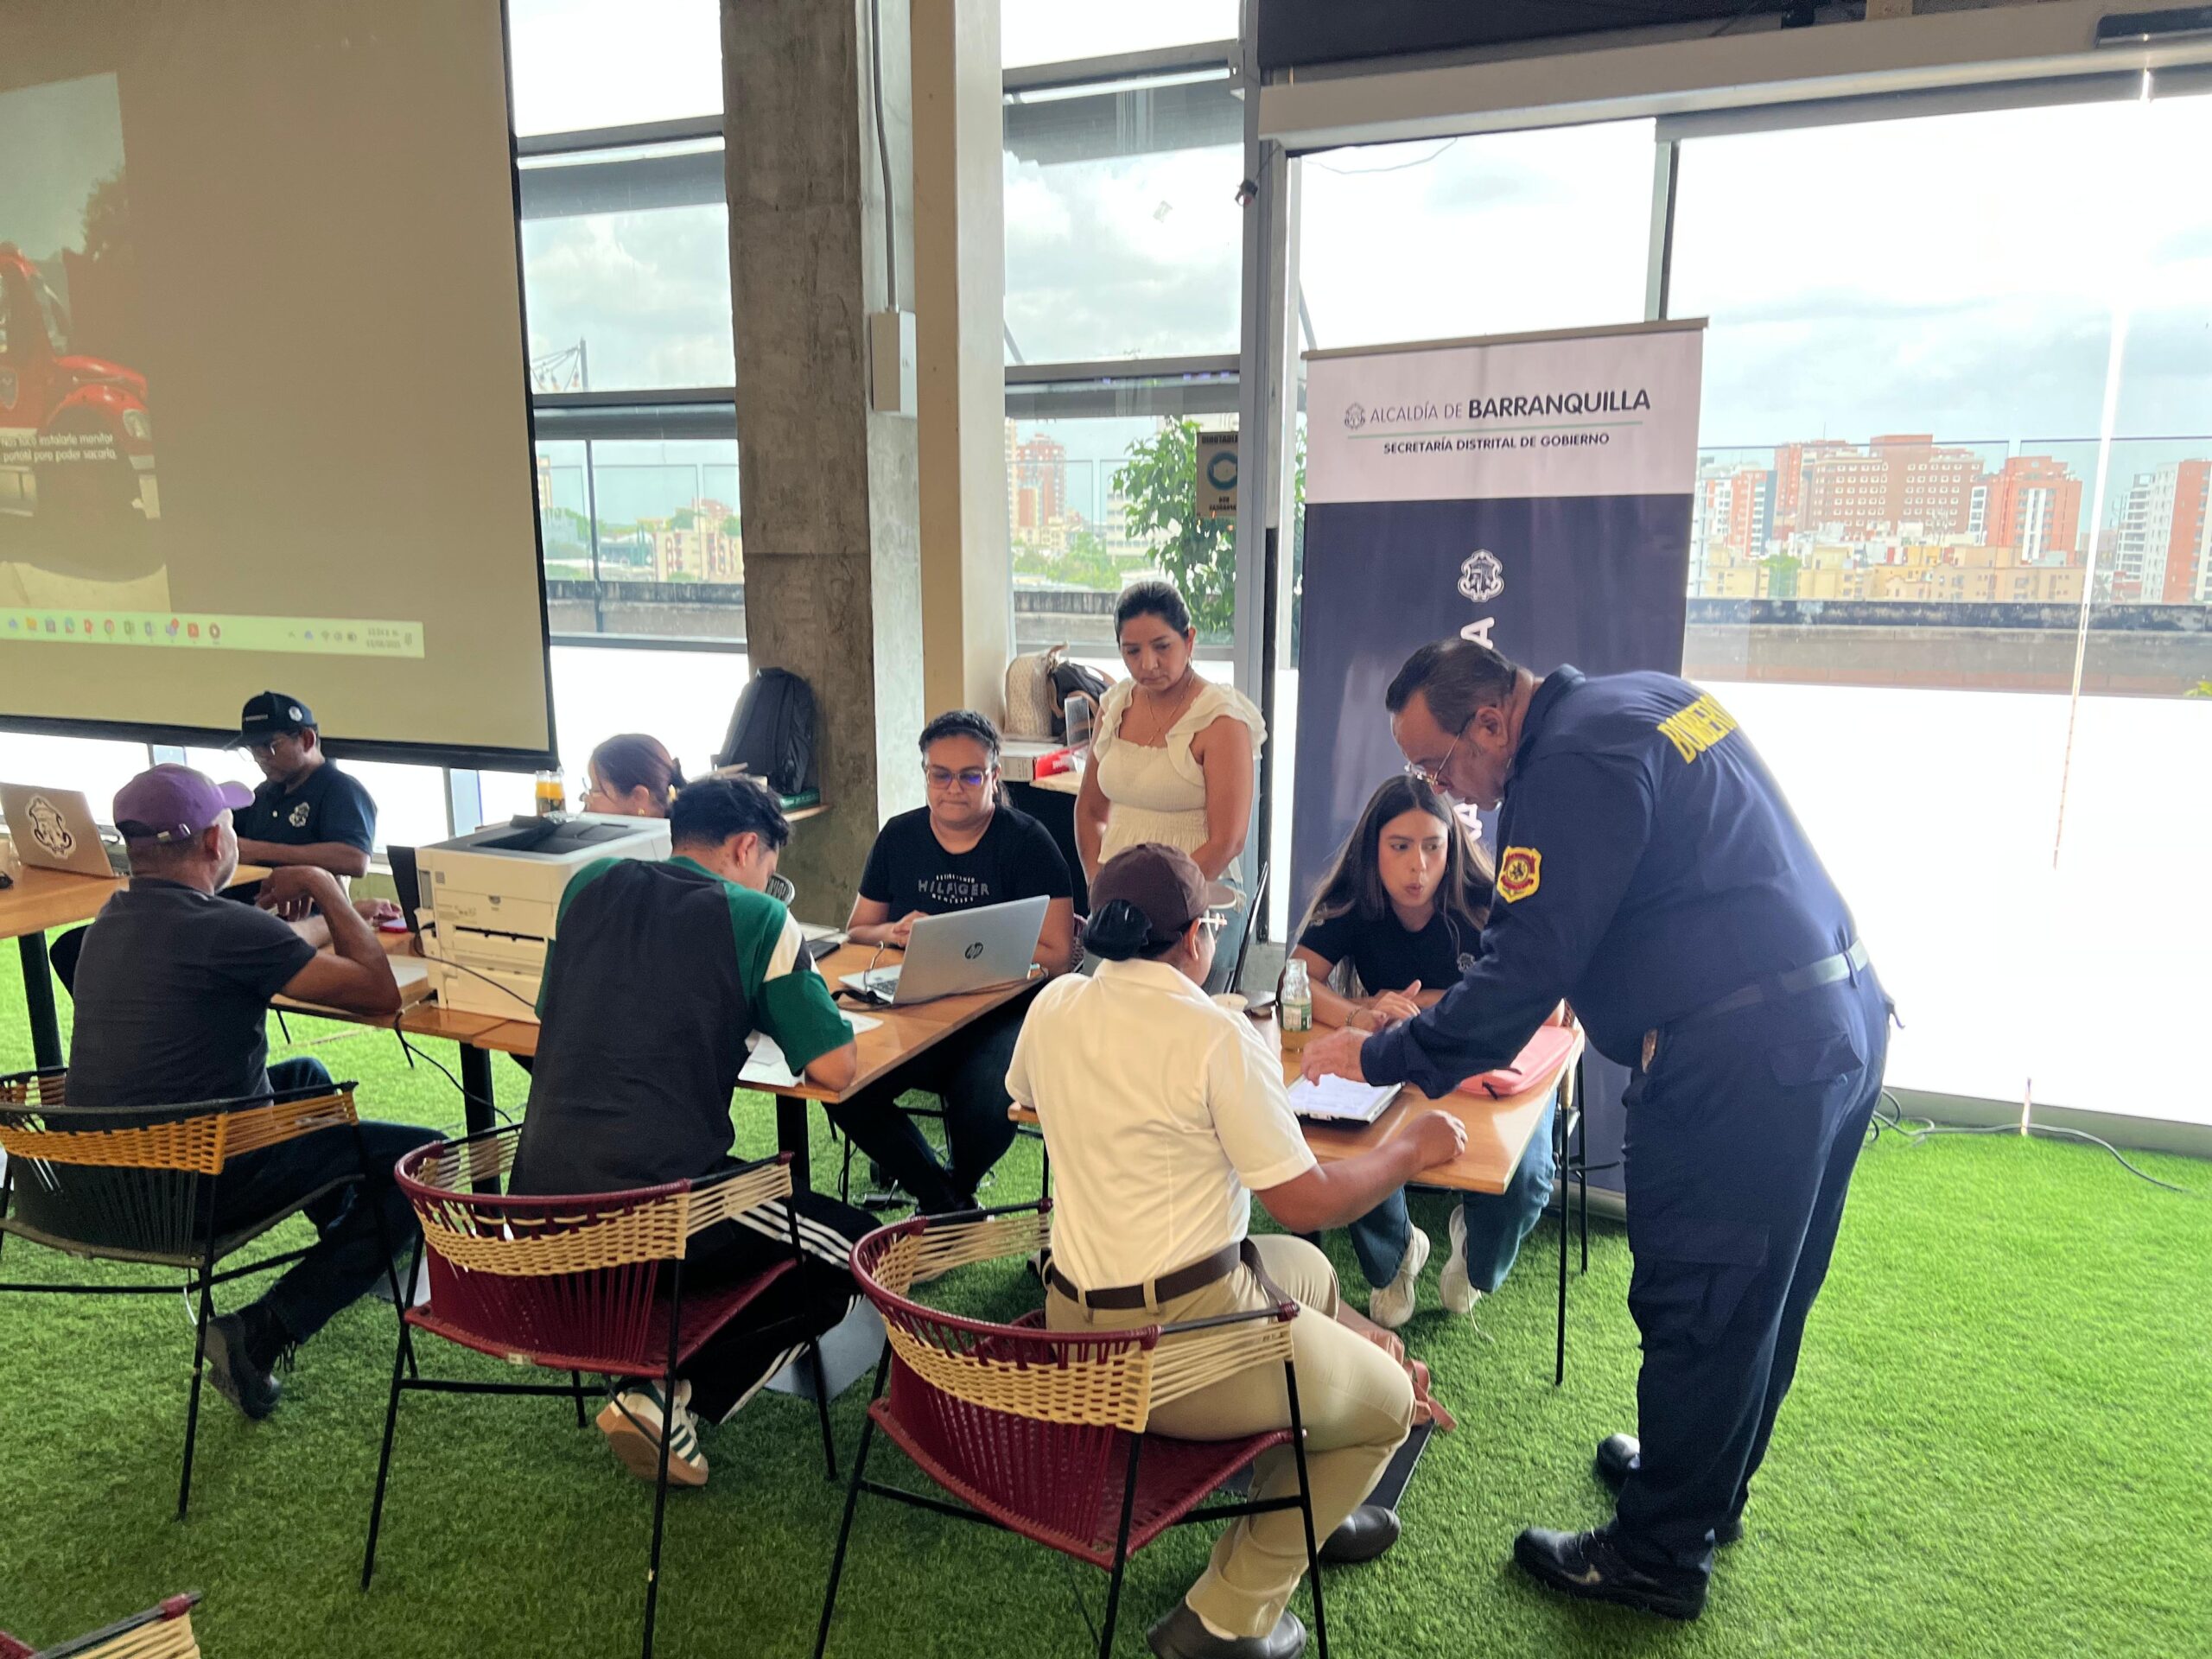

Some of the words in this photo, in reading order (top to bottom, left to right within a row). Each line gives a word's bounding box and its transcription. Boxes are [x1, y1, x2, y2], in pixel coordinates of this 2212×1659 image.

[1370, 400, 1438, 423] ALCALDÍA
[1444, 403, 1463, 420] DE
[1468, 389, 1651, 419] BARRANQUILLA
[1383, 435, 1453, 454] SECRETARÍA
[1456, 435, 1516, 451] DISTRITAL
[1520, 435, 1537, 448] DE
[1541, 432, 1611, 447] GOBIERNO
[918, 879, 989, 896] HILFIGER
